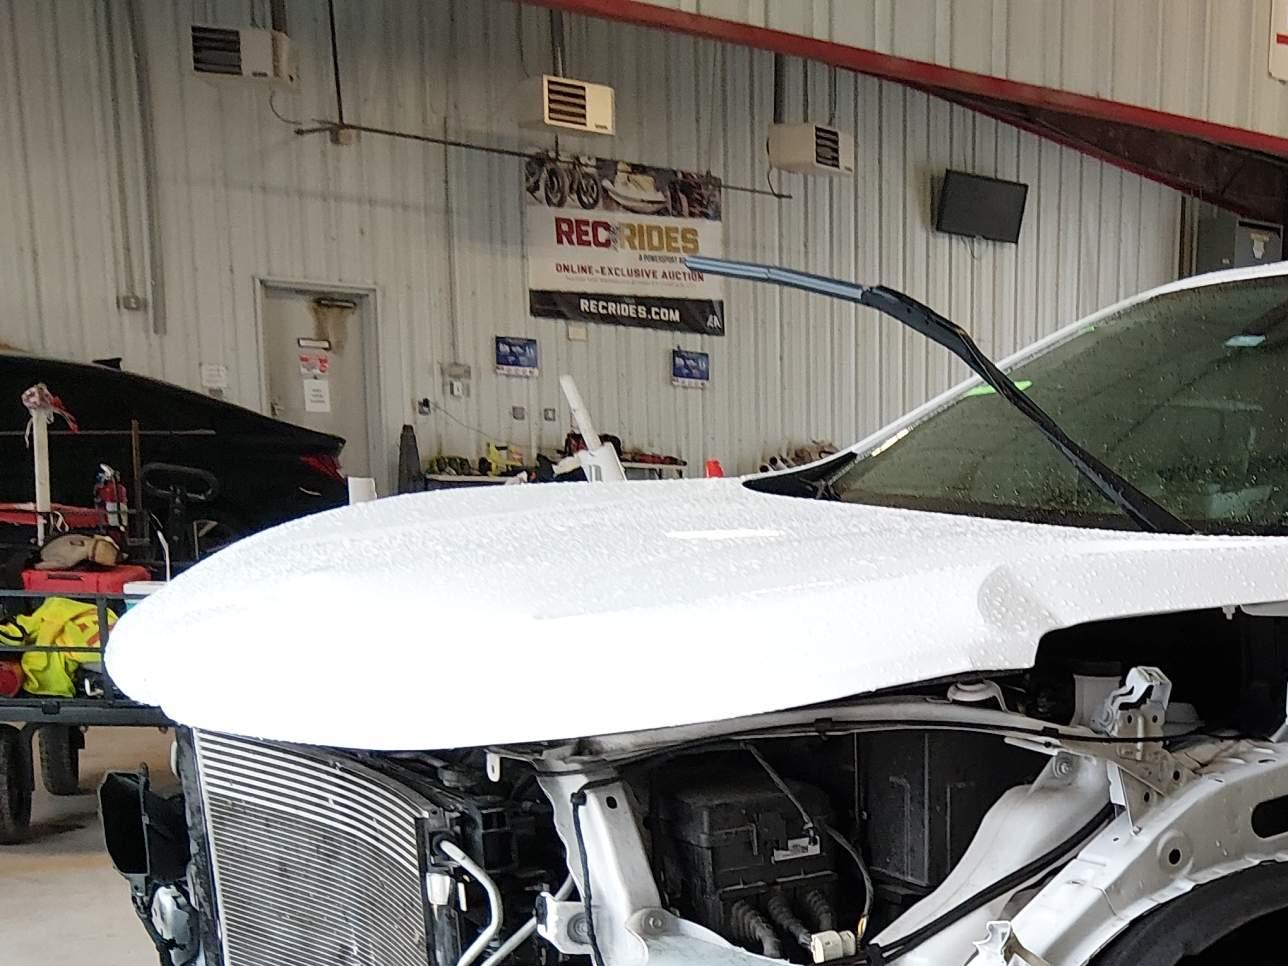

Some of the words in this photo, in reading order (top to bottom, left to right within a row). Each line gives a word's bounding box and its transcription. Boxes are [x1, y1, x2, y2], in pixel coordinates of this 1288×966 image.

[554, 216, 612, 249] REC
[618, 222, 700, 256] RIDES
[661, 269, 705, 282] AUCTION
[580, 298, 681, 323] RECRIDES.COM
